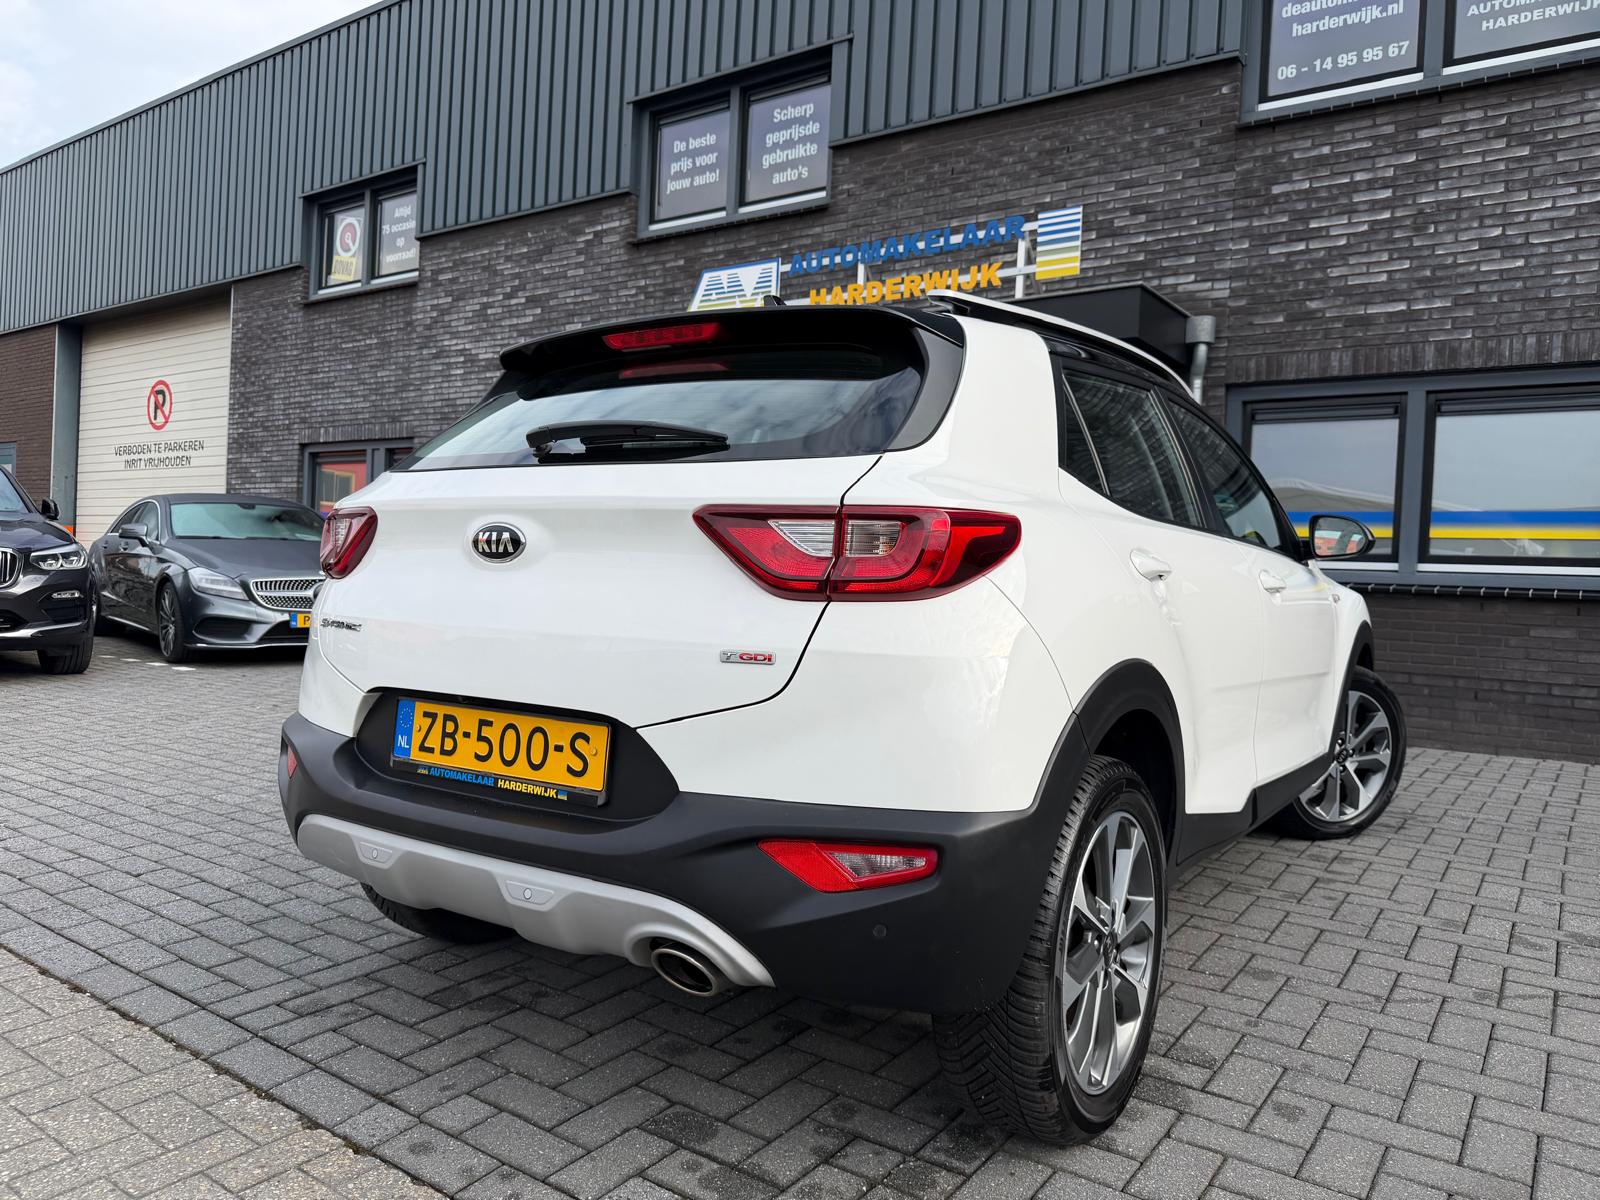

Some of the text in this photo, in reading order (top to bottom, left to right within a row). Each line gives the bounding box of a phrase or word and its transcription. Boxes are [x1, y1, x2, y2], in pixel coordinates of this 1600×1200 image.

[1292, 0, 1404, 37] harderwijk.nl
[1277, 64, 1297, 80] 06
[1313, 57, 1333, 72] 14
[1337, 51, 1358, 68] 95
[1362, 46, 1383, 63] 95
[1387, 40, 1410, 57] 67
[773, 103, 814, 122] Scherp
[673, 133, 717, 153] De beste
[766, 121, 820, 147] geprijsde
[670, 152, 718, 175] prijs voor
[762, 142, 818, 169] gebruikte
[666, 169, 720, 194] jouw auto!
[772, 165, 809, 185] auto's
[788, 215, 1025, 277] AUTOMAKELAAR
[809, 262, 1002, 306] HARDERWIJK
[114, 440, 205, 456] VERBODEN TE PARKEREN
[124, 458, 142, 469] INRIT
[478, 531, 514, 552] KIA
[397, 710, 591, 778] NL ZB-500-S
[429, 766, 558, 799] AUTOMAKELAAR HARDERWIJK
